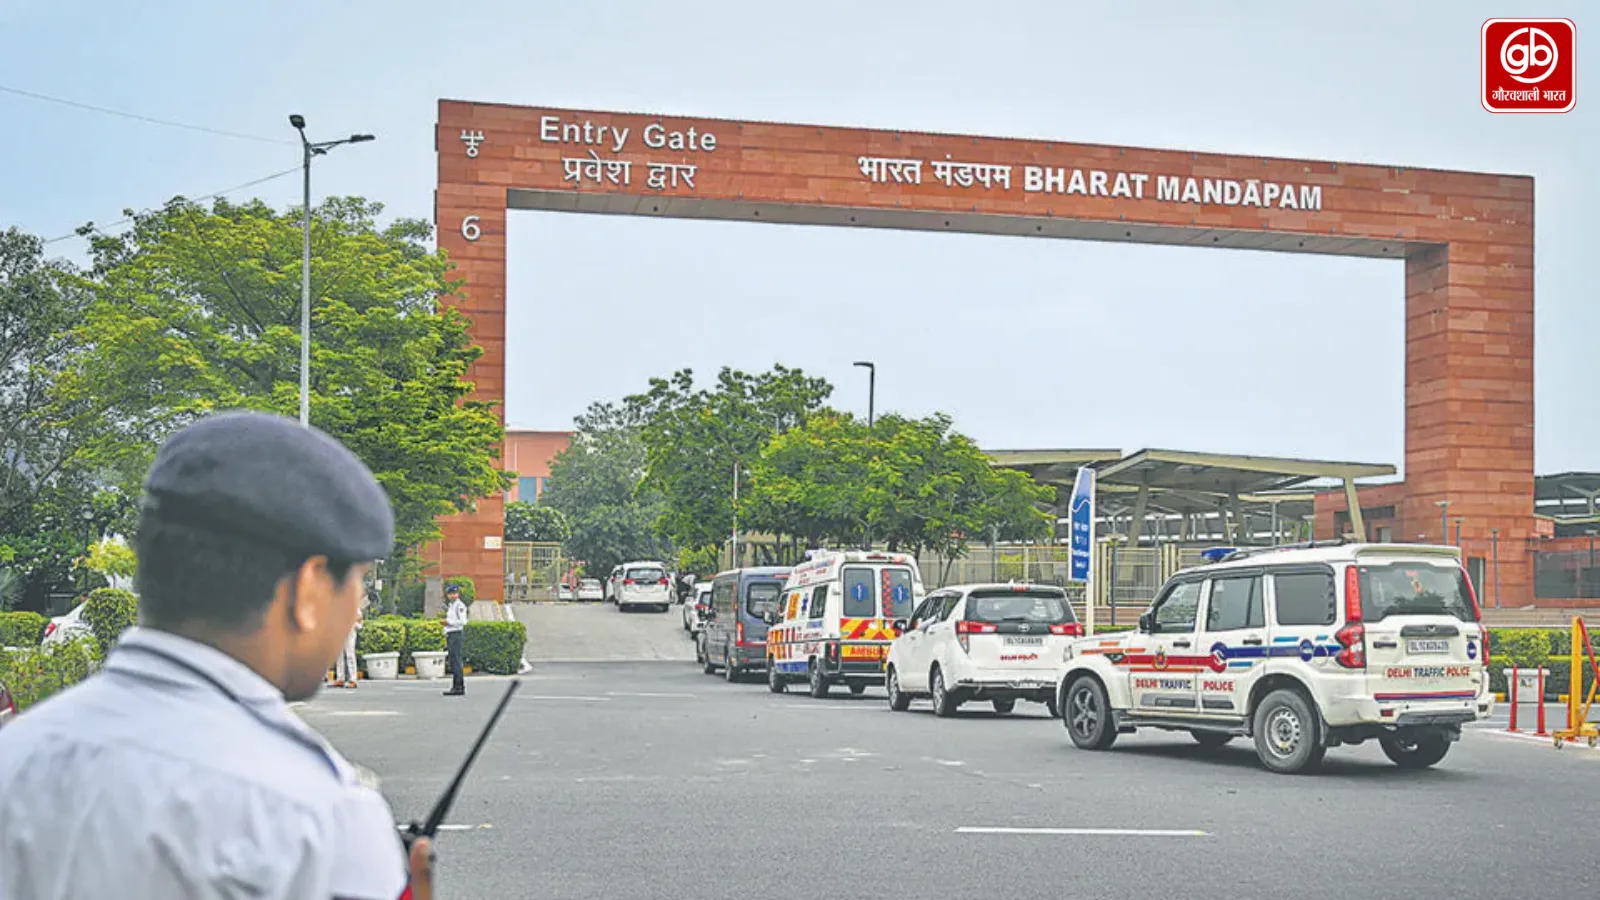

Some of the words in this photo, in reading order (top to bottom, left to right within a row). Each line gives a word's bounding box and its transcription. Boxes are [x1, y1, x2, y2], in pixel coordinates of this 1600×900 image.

[540, 115, 629, 151] Entry
[643, 123, 717, 151] Gate
[561, 150, 632, 186] प्रवेश
[647, 161, 697, 189] द्वार
[858, 155, 922, 185] भारत
[931, 154, 1011, 190] मंडपम
[1024, 166, 1148, 199] BHARAT
[461, 215, 481, 241] 6
[850, 645, 890, 656] AMBUL
[1136, 678, 1158, 688] DELHI
[1160, 679, 1192, 689] TRAFFIC
[1203, 681, 1234, 692] POLICE
[1387, 667, 1412, 678] DELHI
[1414, 666, 1444, 677] TRAFFIC
[1446, 666, 1470, 677] POLICE
